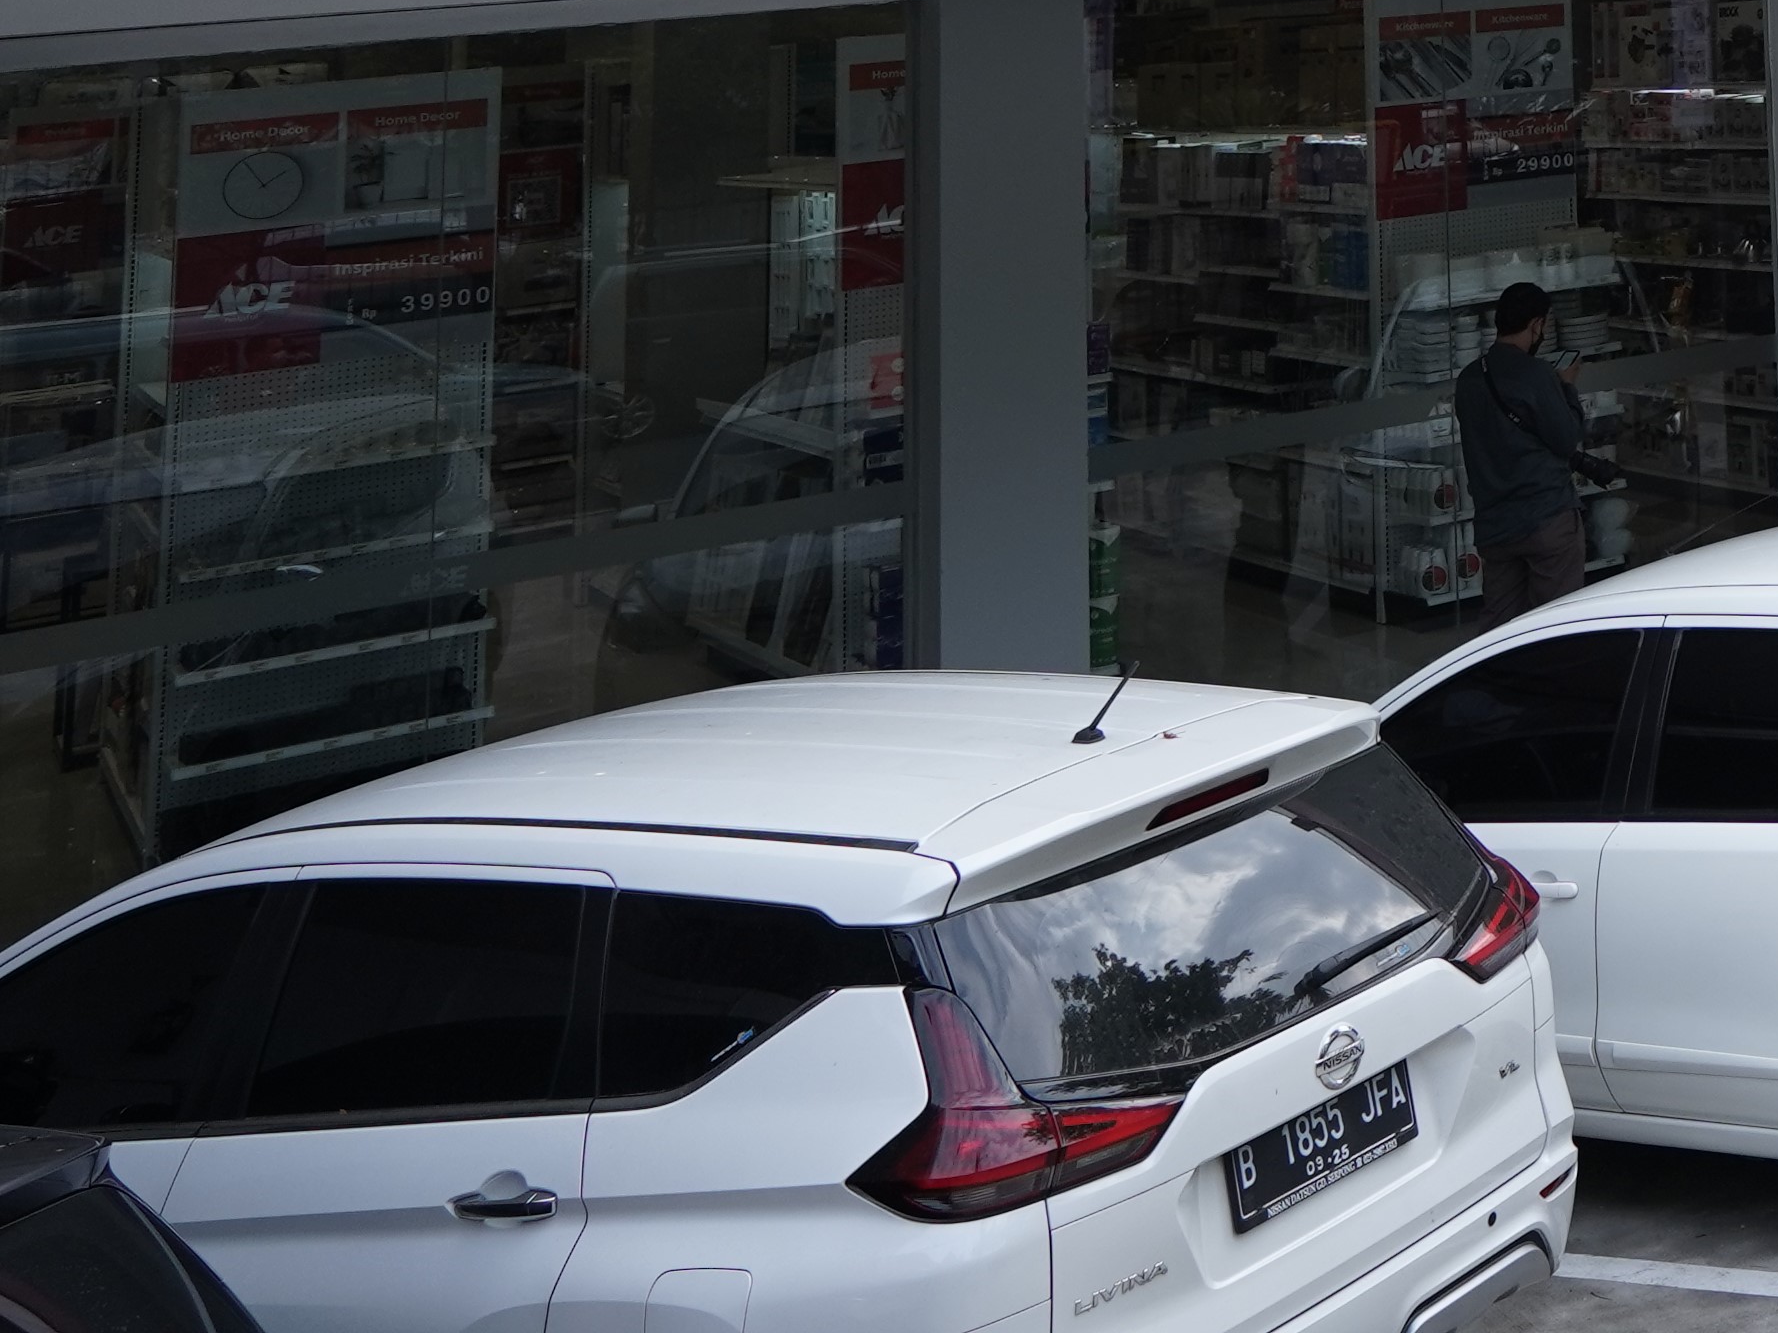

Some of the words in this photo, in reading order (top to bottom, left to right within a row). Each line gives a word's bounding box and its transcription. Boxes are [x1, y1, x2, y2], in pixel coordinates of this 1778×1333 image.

[1394, 17, 1455, 33] Kitchenware
[1491, 10, 1550, 25] Kitchenware
[871, 67, 906, 81] Home
[374, 112, 417, 128] Home
[419, 107, 462, 124] Decor
[218, 125, 264, 143] Home
[267, 121, 312, 139] Decor
[1473, 123, 1523, 142] Inspirasi
[1525, 118, 1569, 137] Terkini
[1393, 142, 1447, 173] ACE
[1516, 151, 1575, 174] 29900
[23, 225, 83, 249] ACE
[333, 256, 415, 278] Inspirasi
[417, 245, 484, 268] Terkini
[202, 280, 296, 320] ACE
[399, 285, 491, 314] 39900
[1322, 1043, 1363, 1072] NISSAN
[1237, 1144, 1257, 1190] B
[1281, 1097, 1345, 1166] 1855
[1361, 1065, 1407, 1123] JFA
[1074, 1260, 1169, 1317] LIVINA
